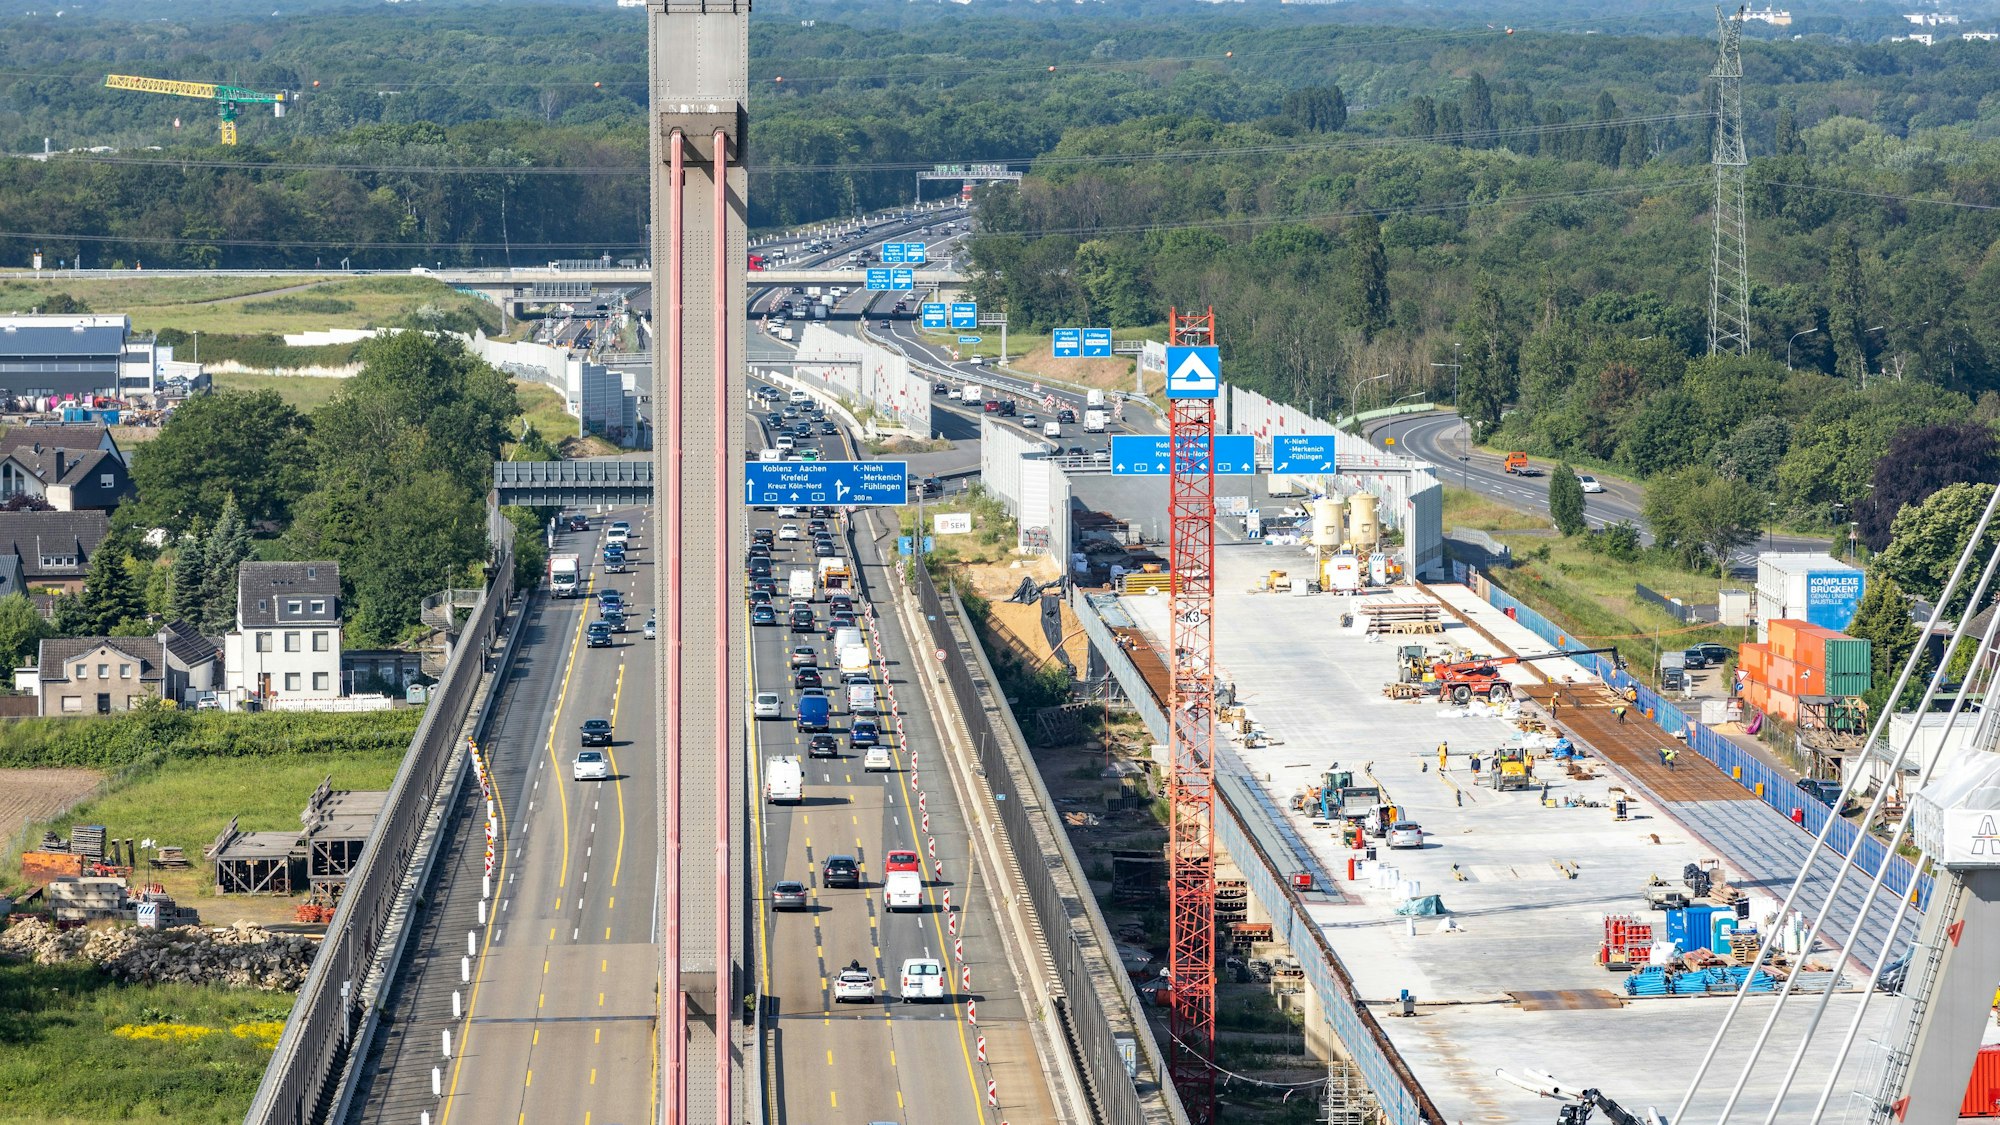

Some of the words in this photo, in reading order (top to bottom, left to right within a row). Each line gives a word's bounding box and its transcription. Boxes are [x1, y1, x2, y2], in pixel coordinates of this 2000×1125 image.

[1288, 453, 1323, 461] -Fühlingen
[763, 464, 792, 473] Koblenz
[798, 464, 827, 473] Aachen
[781, 473, 809, 481] Krefeld
[860, 473, 902, 481] -Merkenich
[860, 482, 901, 491] -Fühlingen
[1811, 577, 1859, 586] KOMPLEXE
[1811, 584, 1859, 593] BRÜCKEN?
[1186, 611, 1200, 623] K3
